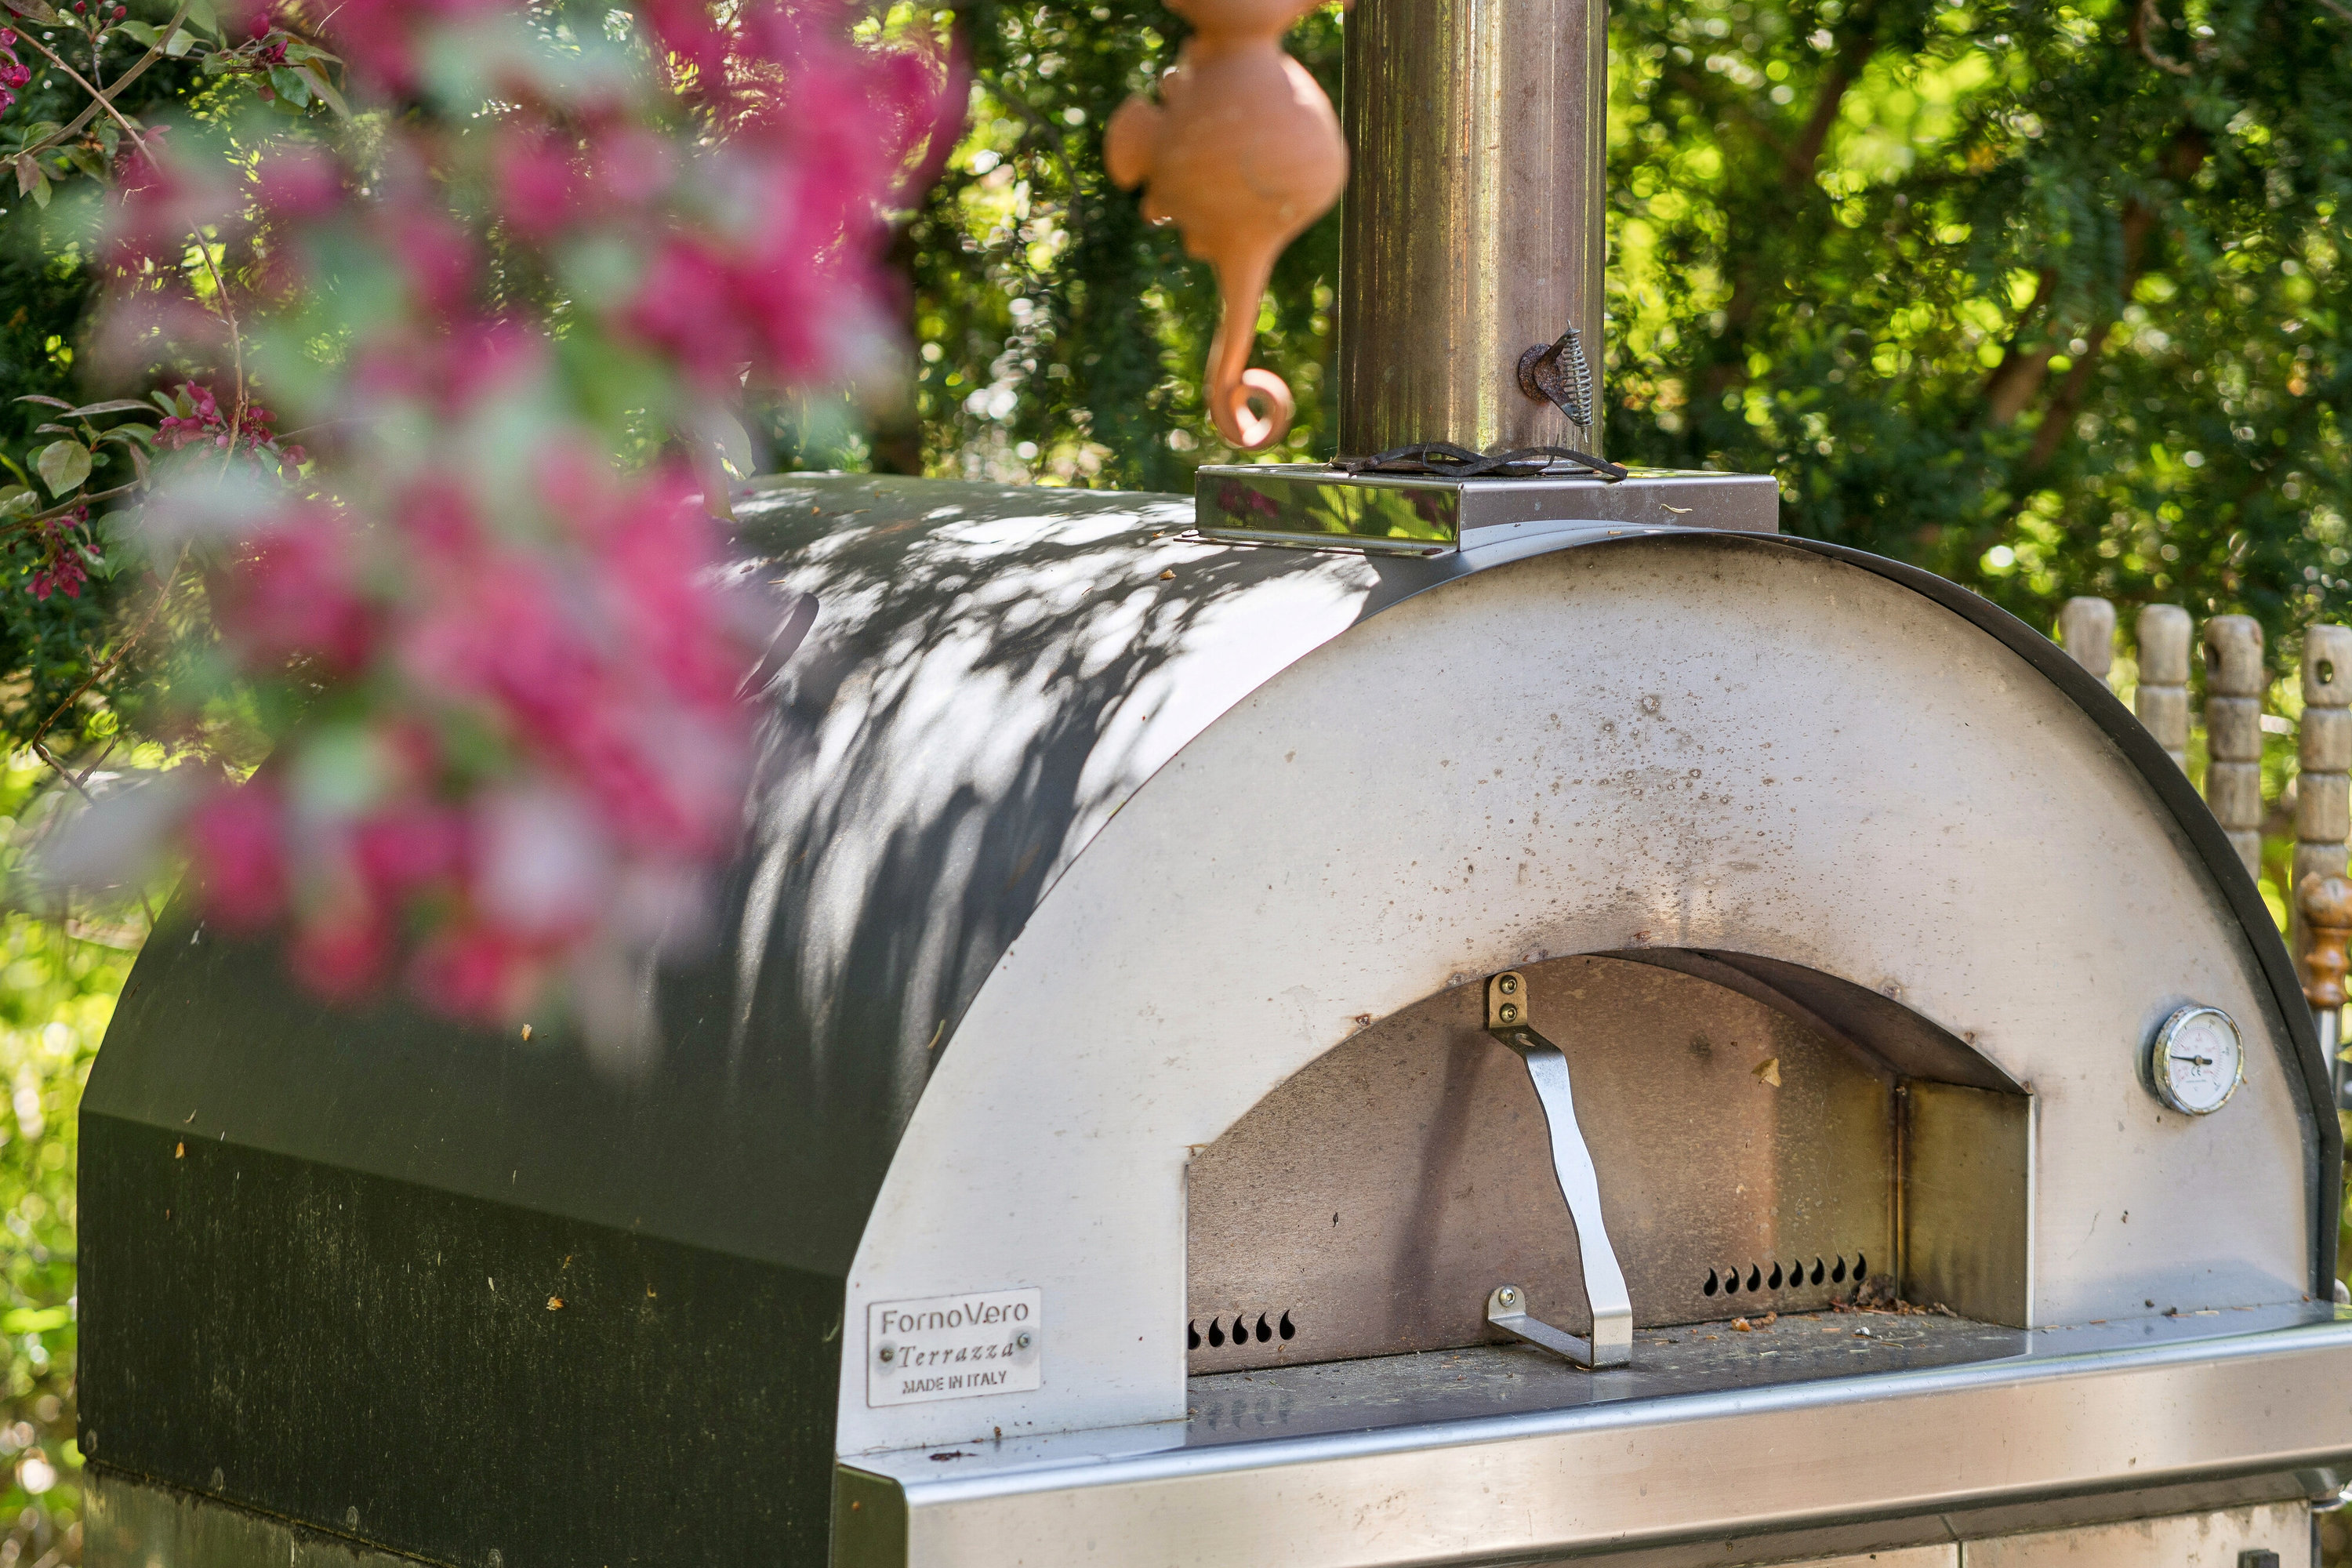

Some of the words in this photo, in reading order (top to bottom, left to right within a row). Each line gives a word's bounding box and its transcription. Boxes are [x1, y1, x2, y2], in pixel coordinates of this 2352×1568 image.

[882, 1301, 1029, 1334] FornoVero
[898, 1342, 1014, 1368] Terrazza
[902, 1377, 944, 1394] MADE
[949, 1375, 963, 1389] IN
[967, 1370, 1007, 1388] ITALY
